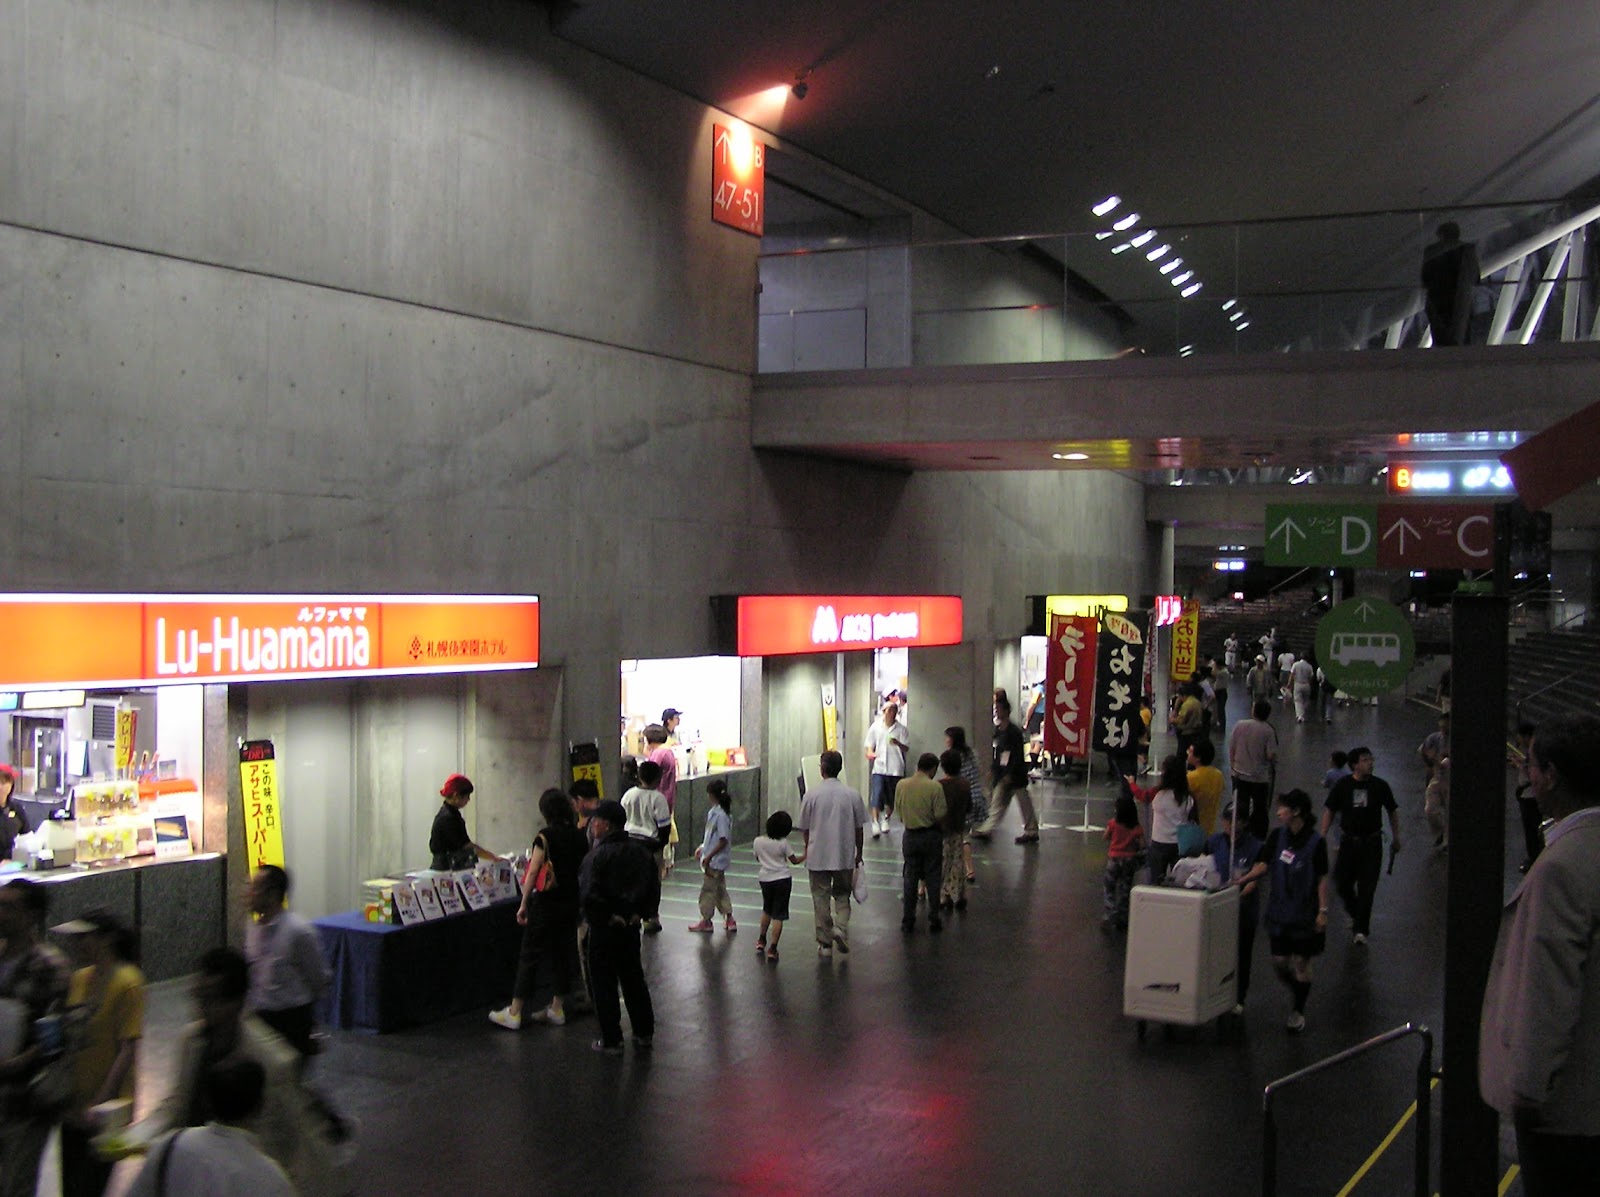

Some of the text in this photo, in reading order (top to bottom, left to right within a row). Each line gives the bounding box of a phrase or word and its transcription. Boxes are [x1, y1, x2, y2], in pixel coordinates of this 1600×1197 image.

[755, 145, 763, 168] B
[715, 180, 759, 222] 47-51
[1341, 516, 1371, 555] D
[1457, 516, 1489, 557] C
[297, 607, 368, 623] ルファママ
[156, 616, 370, 674] Lu-Huamama
[1053, 625, 1085, 743] ラーメン
[1102, 644, 1136, 748] おそば
